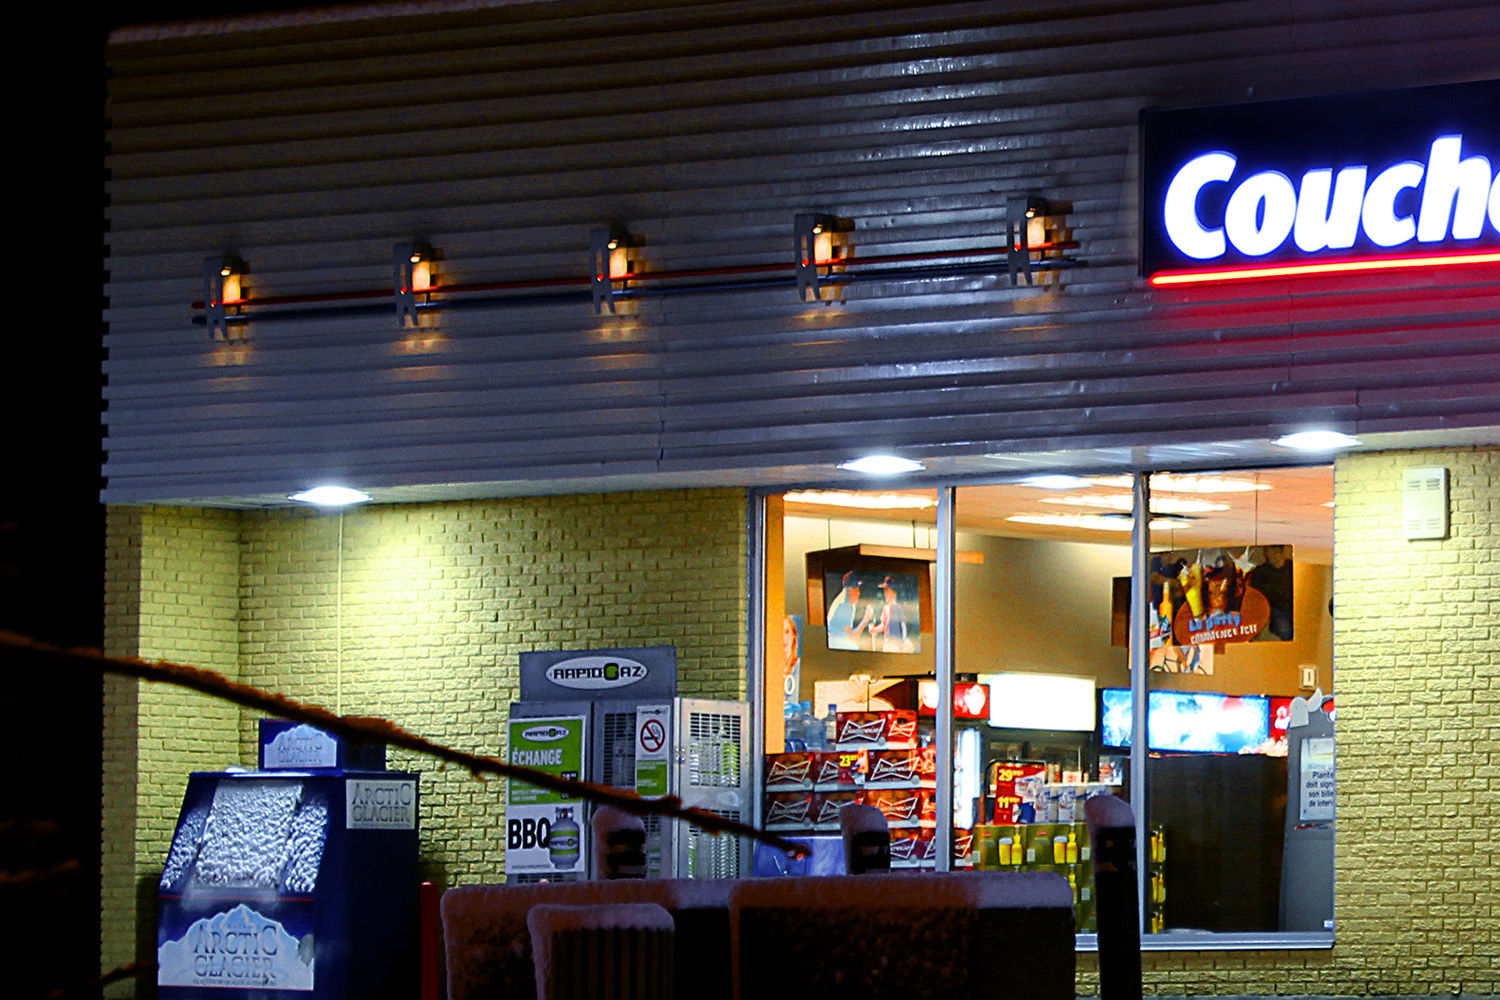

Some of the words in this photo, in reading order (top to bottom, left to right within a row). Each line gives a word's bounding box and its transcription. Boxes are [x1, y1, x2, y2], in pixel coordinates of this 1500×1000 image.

[511, 747, 563, 766] ÉCHANGE
[352, 783, 412, 806] ARCTIC
[352, 805, 411, 823] GLACIER
[508, 817, 551, 850] BBQ
[192, 925, 278, 956] ARCTIC
[194, 955, 276, 980] GLACIER
